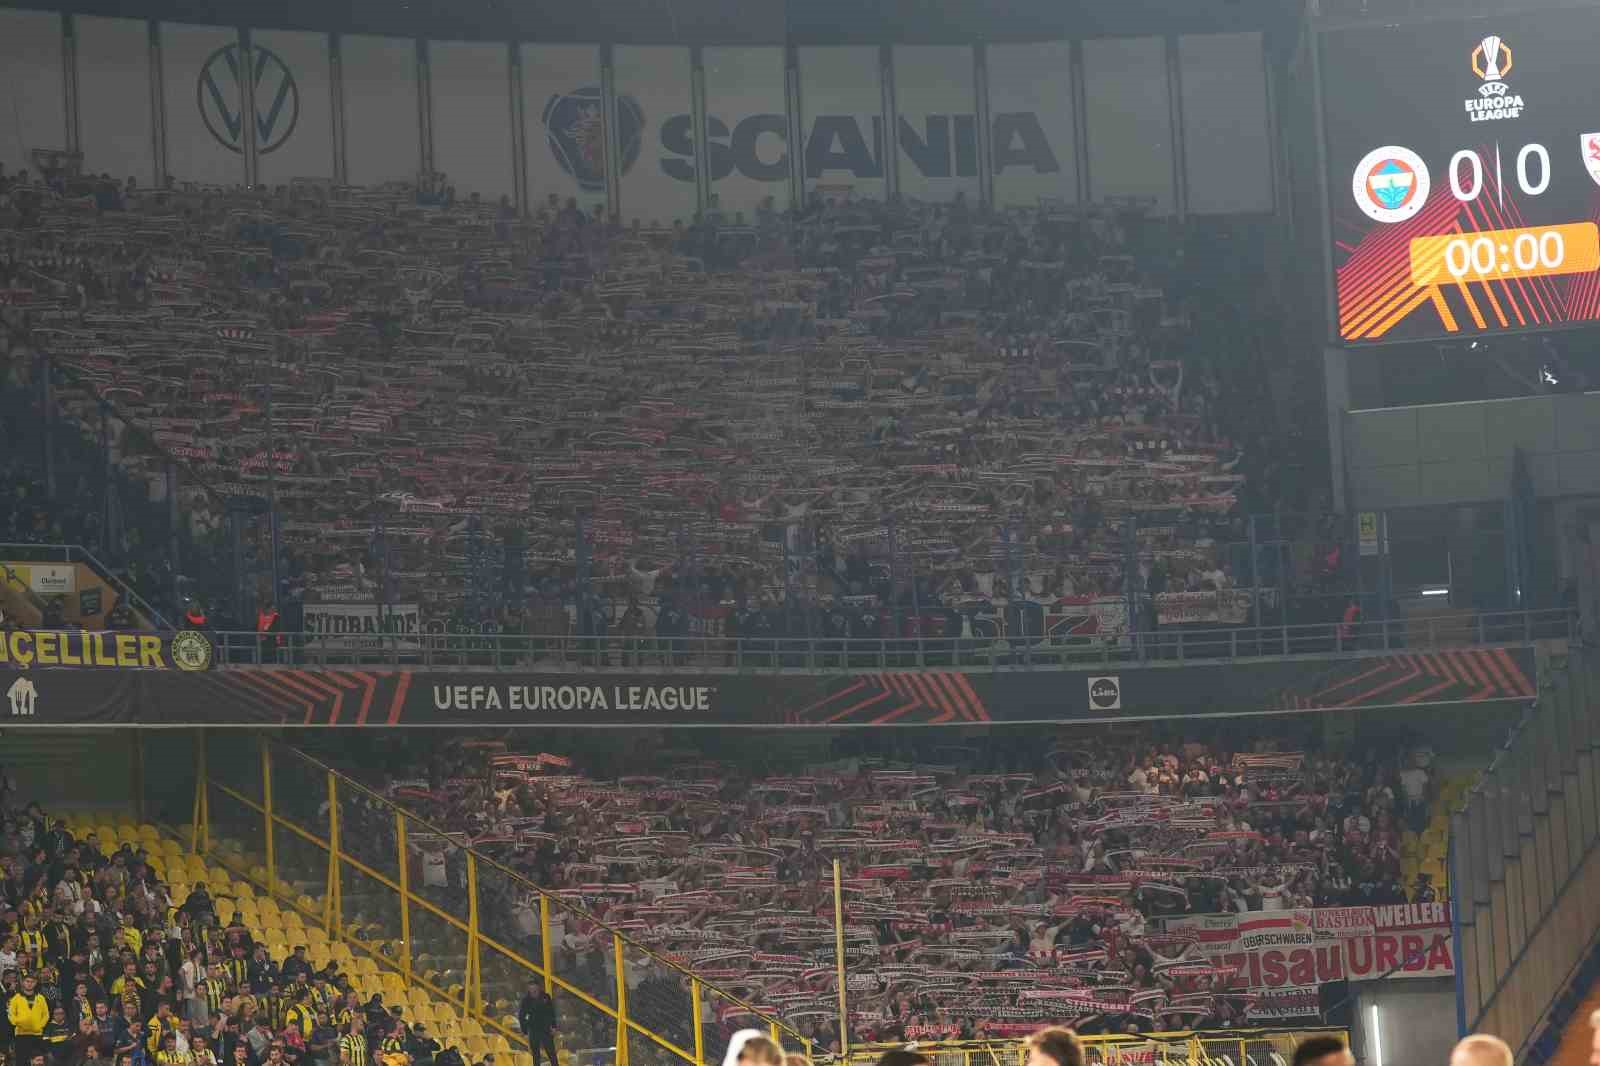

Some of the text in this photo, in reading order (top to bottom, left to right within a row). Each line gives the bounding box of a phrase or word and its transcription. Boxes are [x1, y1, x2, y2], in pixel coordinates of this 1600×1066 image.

[1464, 95, 1525, 111] EUROPA
[1470, 108, 1520, 122] LEAGUE
[657, 112, 1060, 182] SCANIA
[1449, 143, 1551, 201] 0 0
[1445, 230, 1565, 278] 00:00
[433, 686, 710, 711] UEFA EUROPA LEAGUE
[1375, 902, 1444, 927] WEILER
